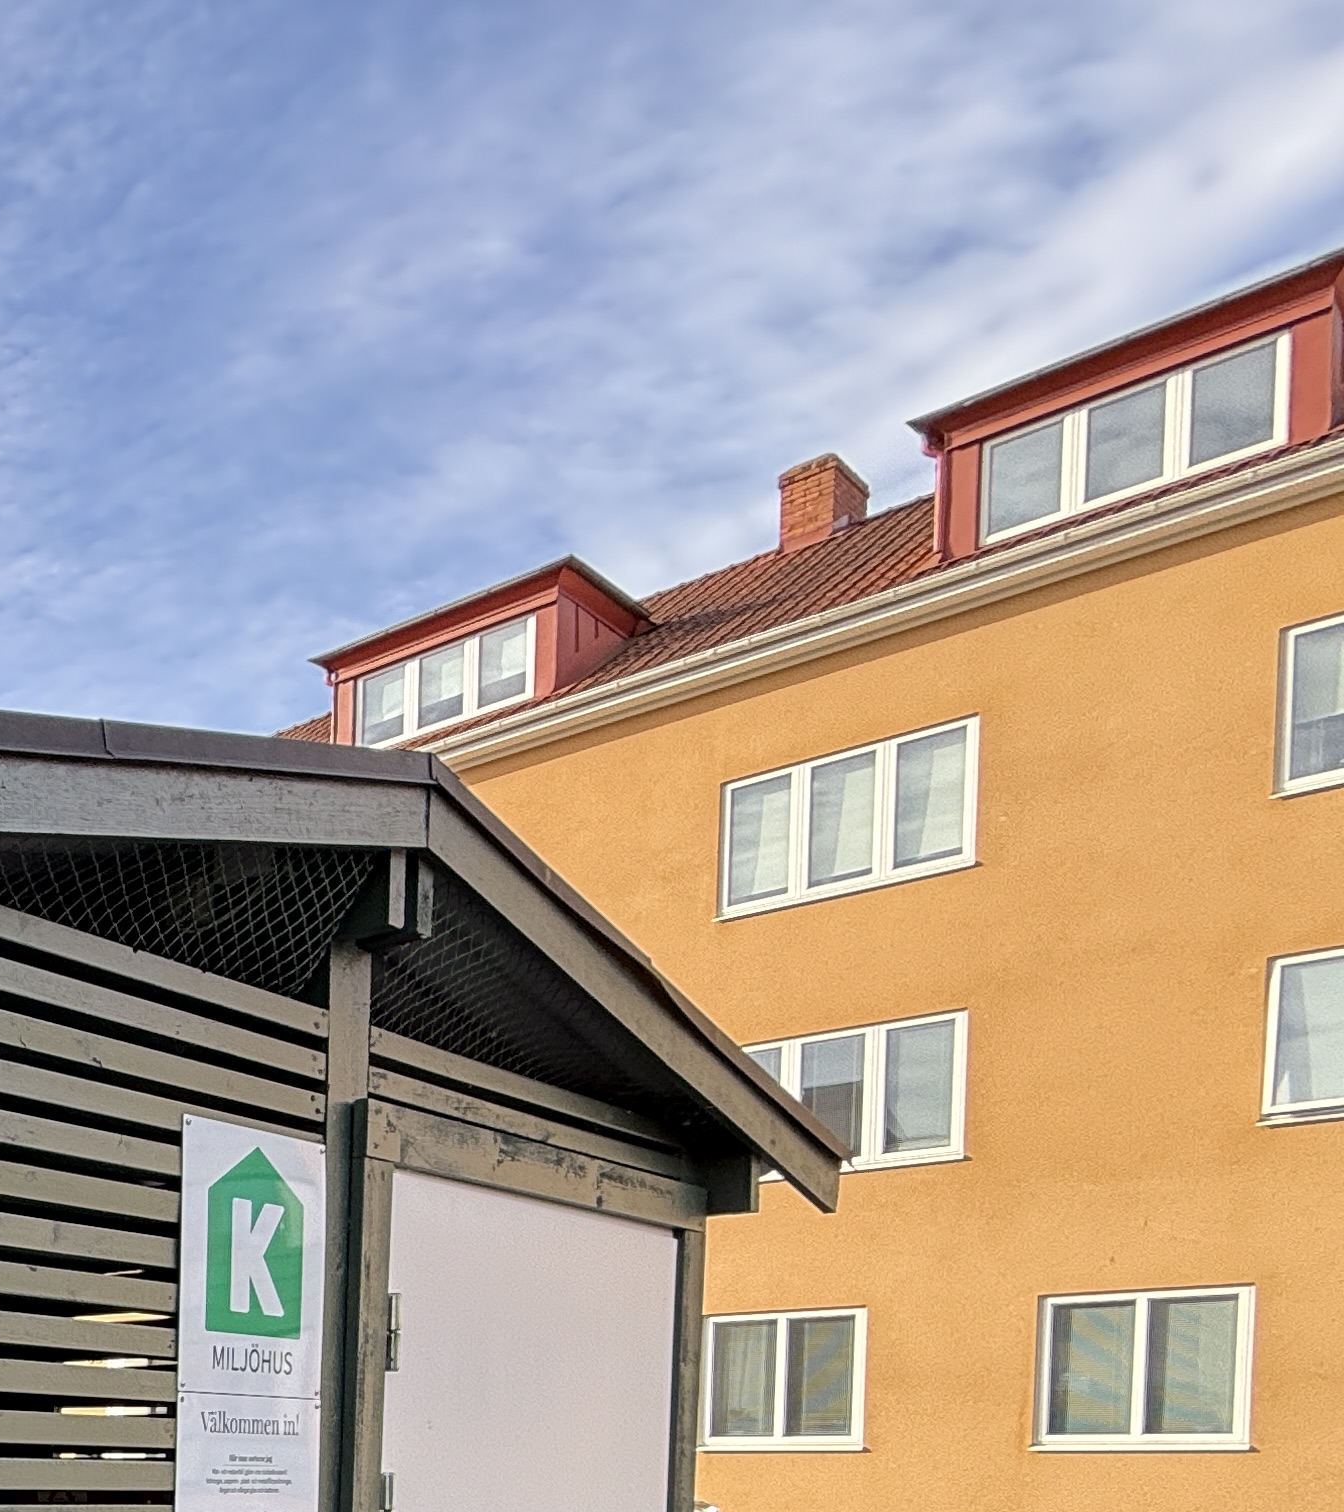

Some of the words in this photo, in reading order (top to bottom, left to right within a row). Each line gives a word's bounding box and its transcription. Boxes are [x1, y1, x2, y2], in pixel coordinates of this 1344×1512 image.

[229, 1197, 285, 1318] K
[211, 1343, 293, 1376] MILJÖHUS
[200, 1410, 281, 1436] Välkommen
[283, 1413, 300, 1436] in!
